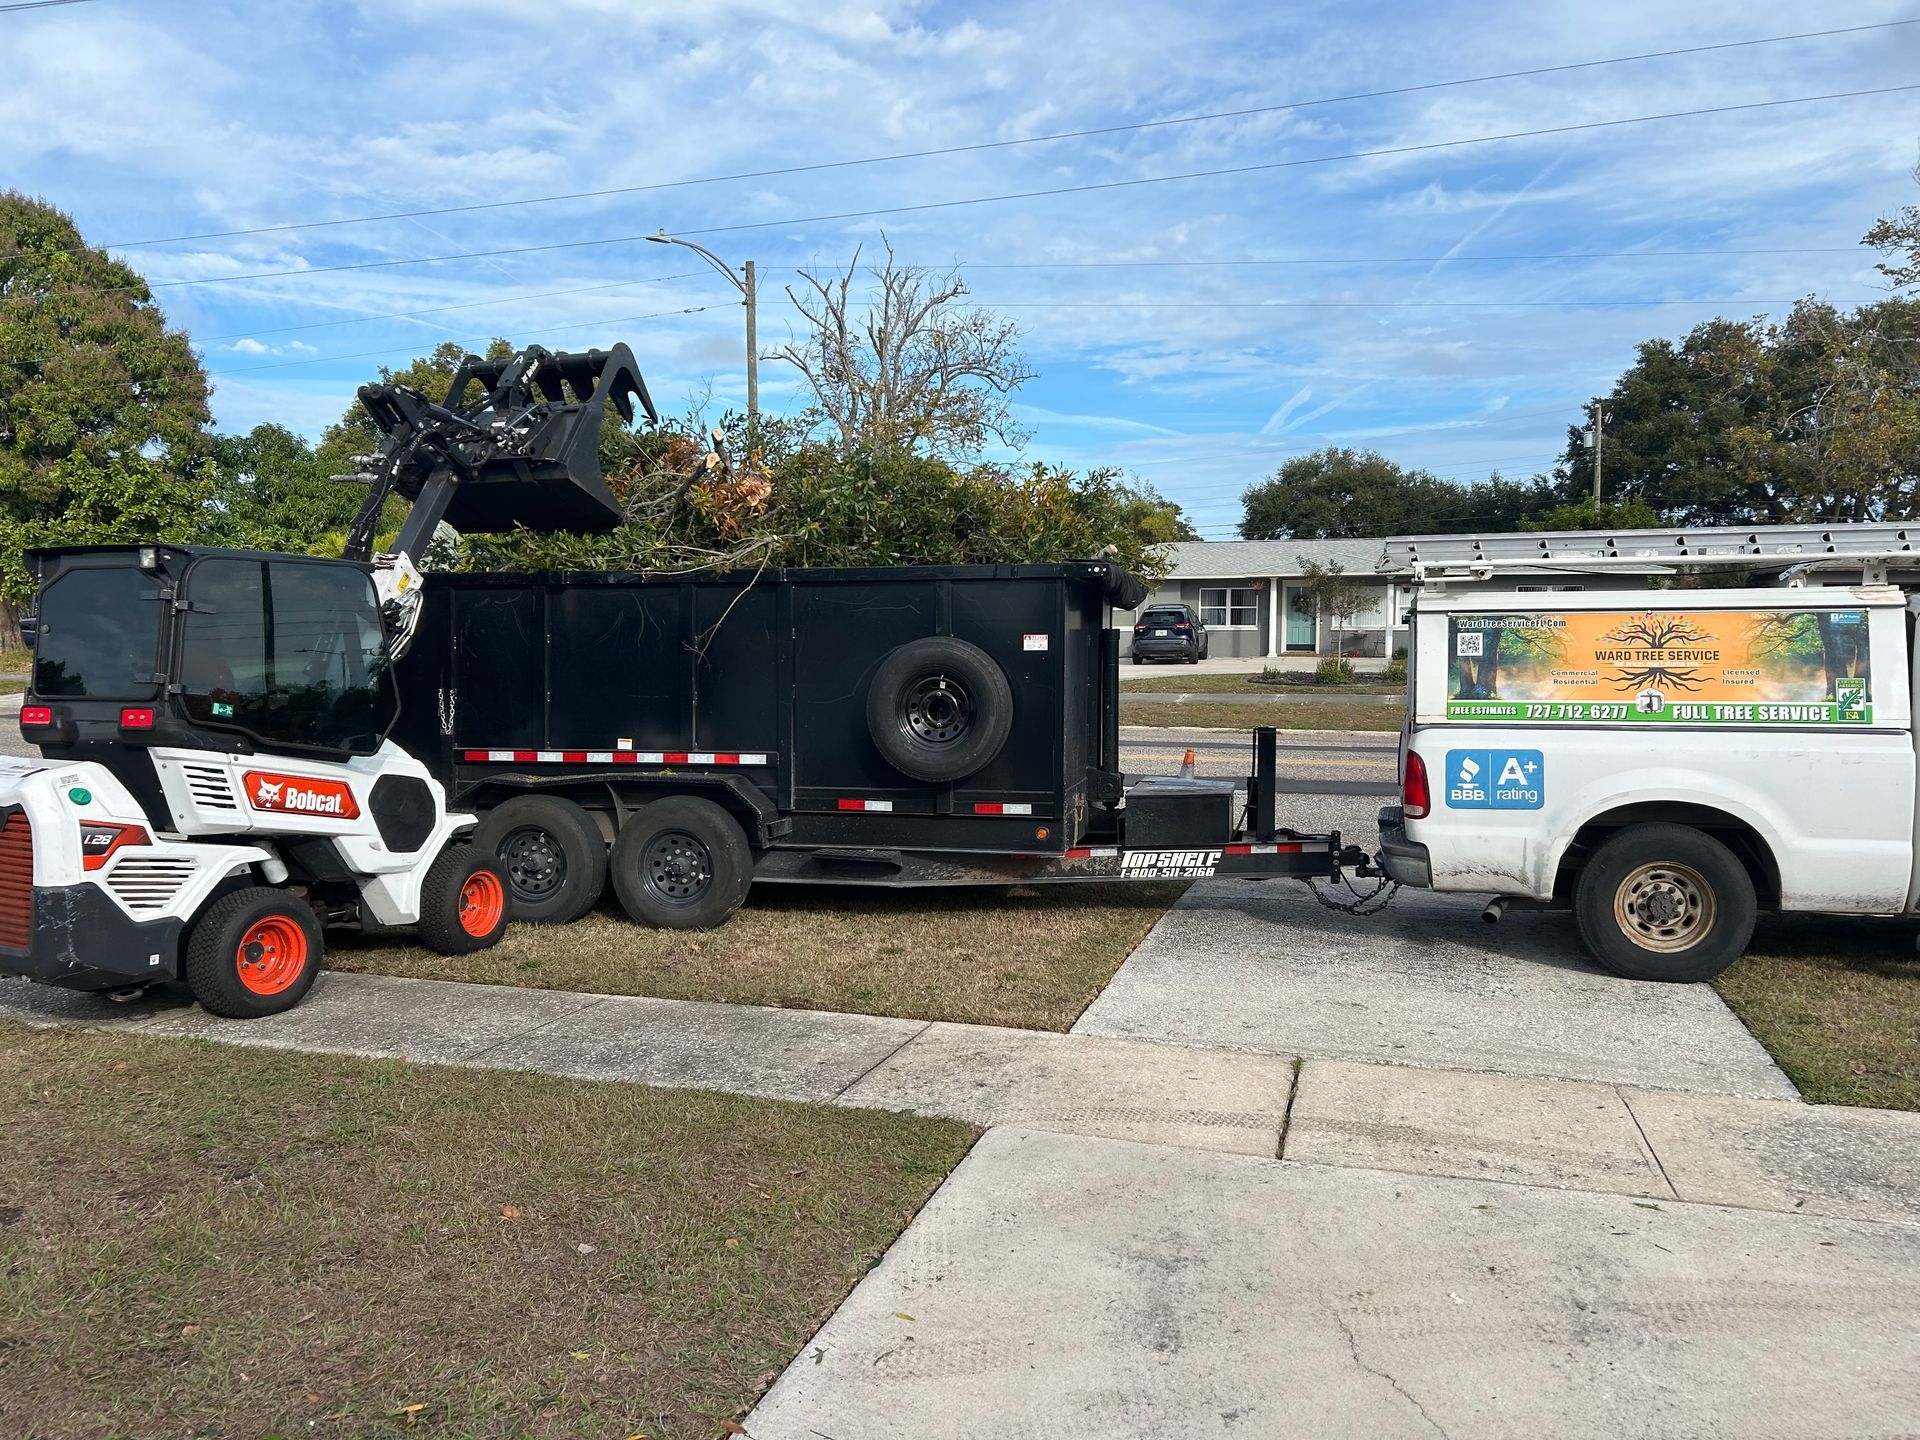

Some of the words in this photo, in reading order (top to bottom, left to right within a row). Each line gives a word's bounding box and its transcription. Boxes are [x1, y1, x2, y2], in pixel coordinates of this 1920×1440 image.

[1595, 650, 1631, 661] WARD
[1635, 650, 1664, 661] TREE
[1668, 650, 1720, 661] SERVICE
[1450, 706, 1470, 715] FREE
[1472, 706, 1517, 716] ESTIMATES
[1525, 704, 1628, 720] 727-712-6277
[1672, 705, 1710, 720] FULL
[1713, 705, 1754, 721] TREE
[1758, 706, 1831, 721] SERVICE
[1845, 711, 1860, 720] ISA
[1497, 757, 1538, 786] A+
[285, 787, 342, 813] Bobcat
[1451, 789, 1486, 801] BBB
[1496, 787, 1538, 803] rating
[1120, 867, 1216, 878] 1-800-511-2168
